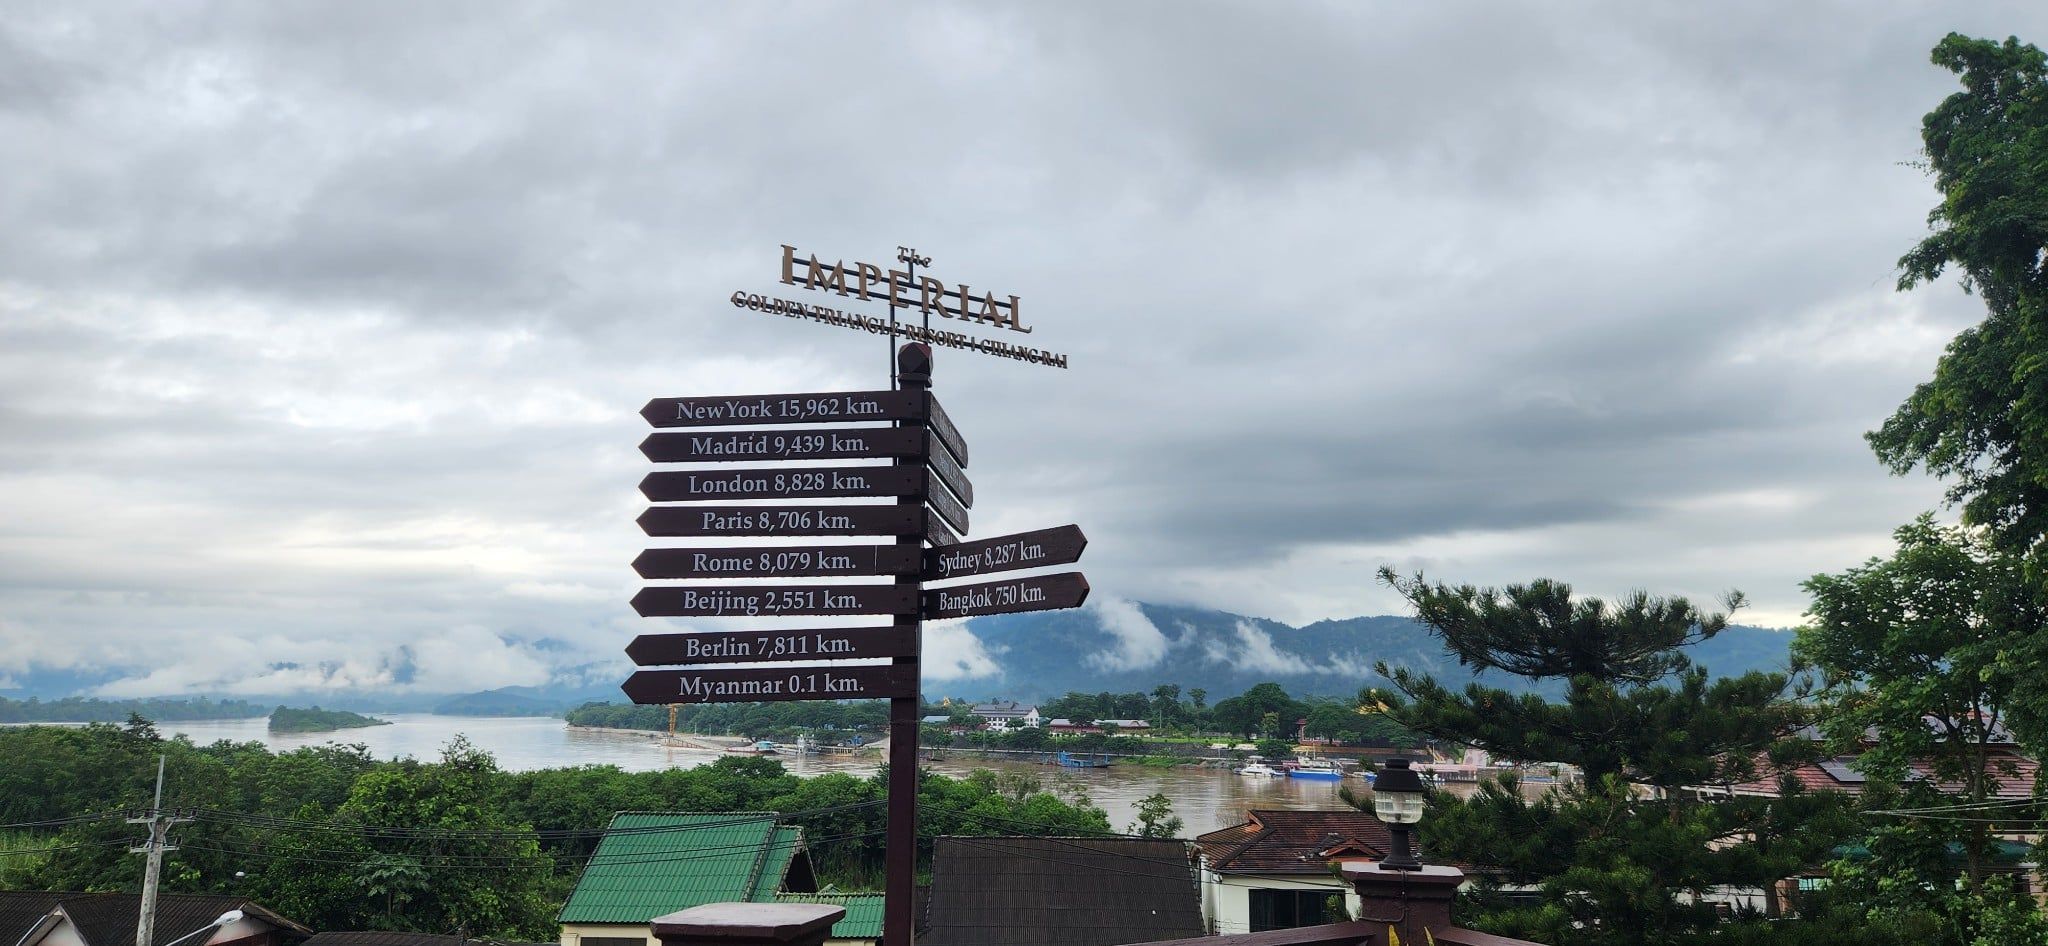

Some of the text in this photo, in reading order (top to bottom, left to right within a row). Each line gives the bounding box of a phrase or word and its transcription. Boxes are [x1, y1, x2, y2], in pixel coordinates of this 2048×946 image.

[897, 246, 932, 268] The
[780, 244, 1032, 334] IMPERIAL
[732, 290, 1068, 369] GOLDEN TRIANGLE RESORT CHIANG RAI
[778, 398, 840, 420] 15,962
[845, 396, 885, 415] km.
[690, 433, 870, 457] Madrid 9,439 km.
[688, 471, 871, 495] London 8,828 km.
[701, 510, 856, 532] Paris 8,706 km.
[692, 551, 857, 574] Rome 8,079 km.
[938, 540, 1046, 576] Sydney 8,287 km.
[683, 589, 863, 615] Beijing 2,551 km.
[939, 582, 1046, 615] Bangkok 750 km.
[686, 634, 856, 658] Berlin 7,811 km.
[678, 673, 865, 701] Myanmar 0.1 km.
